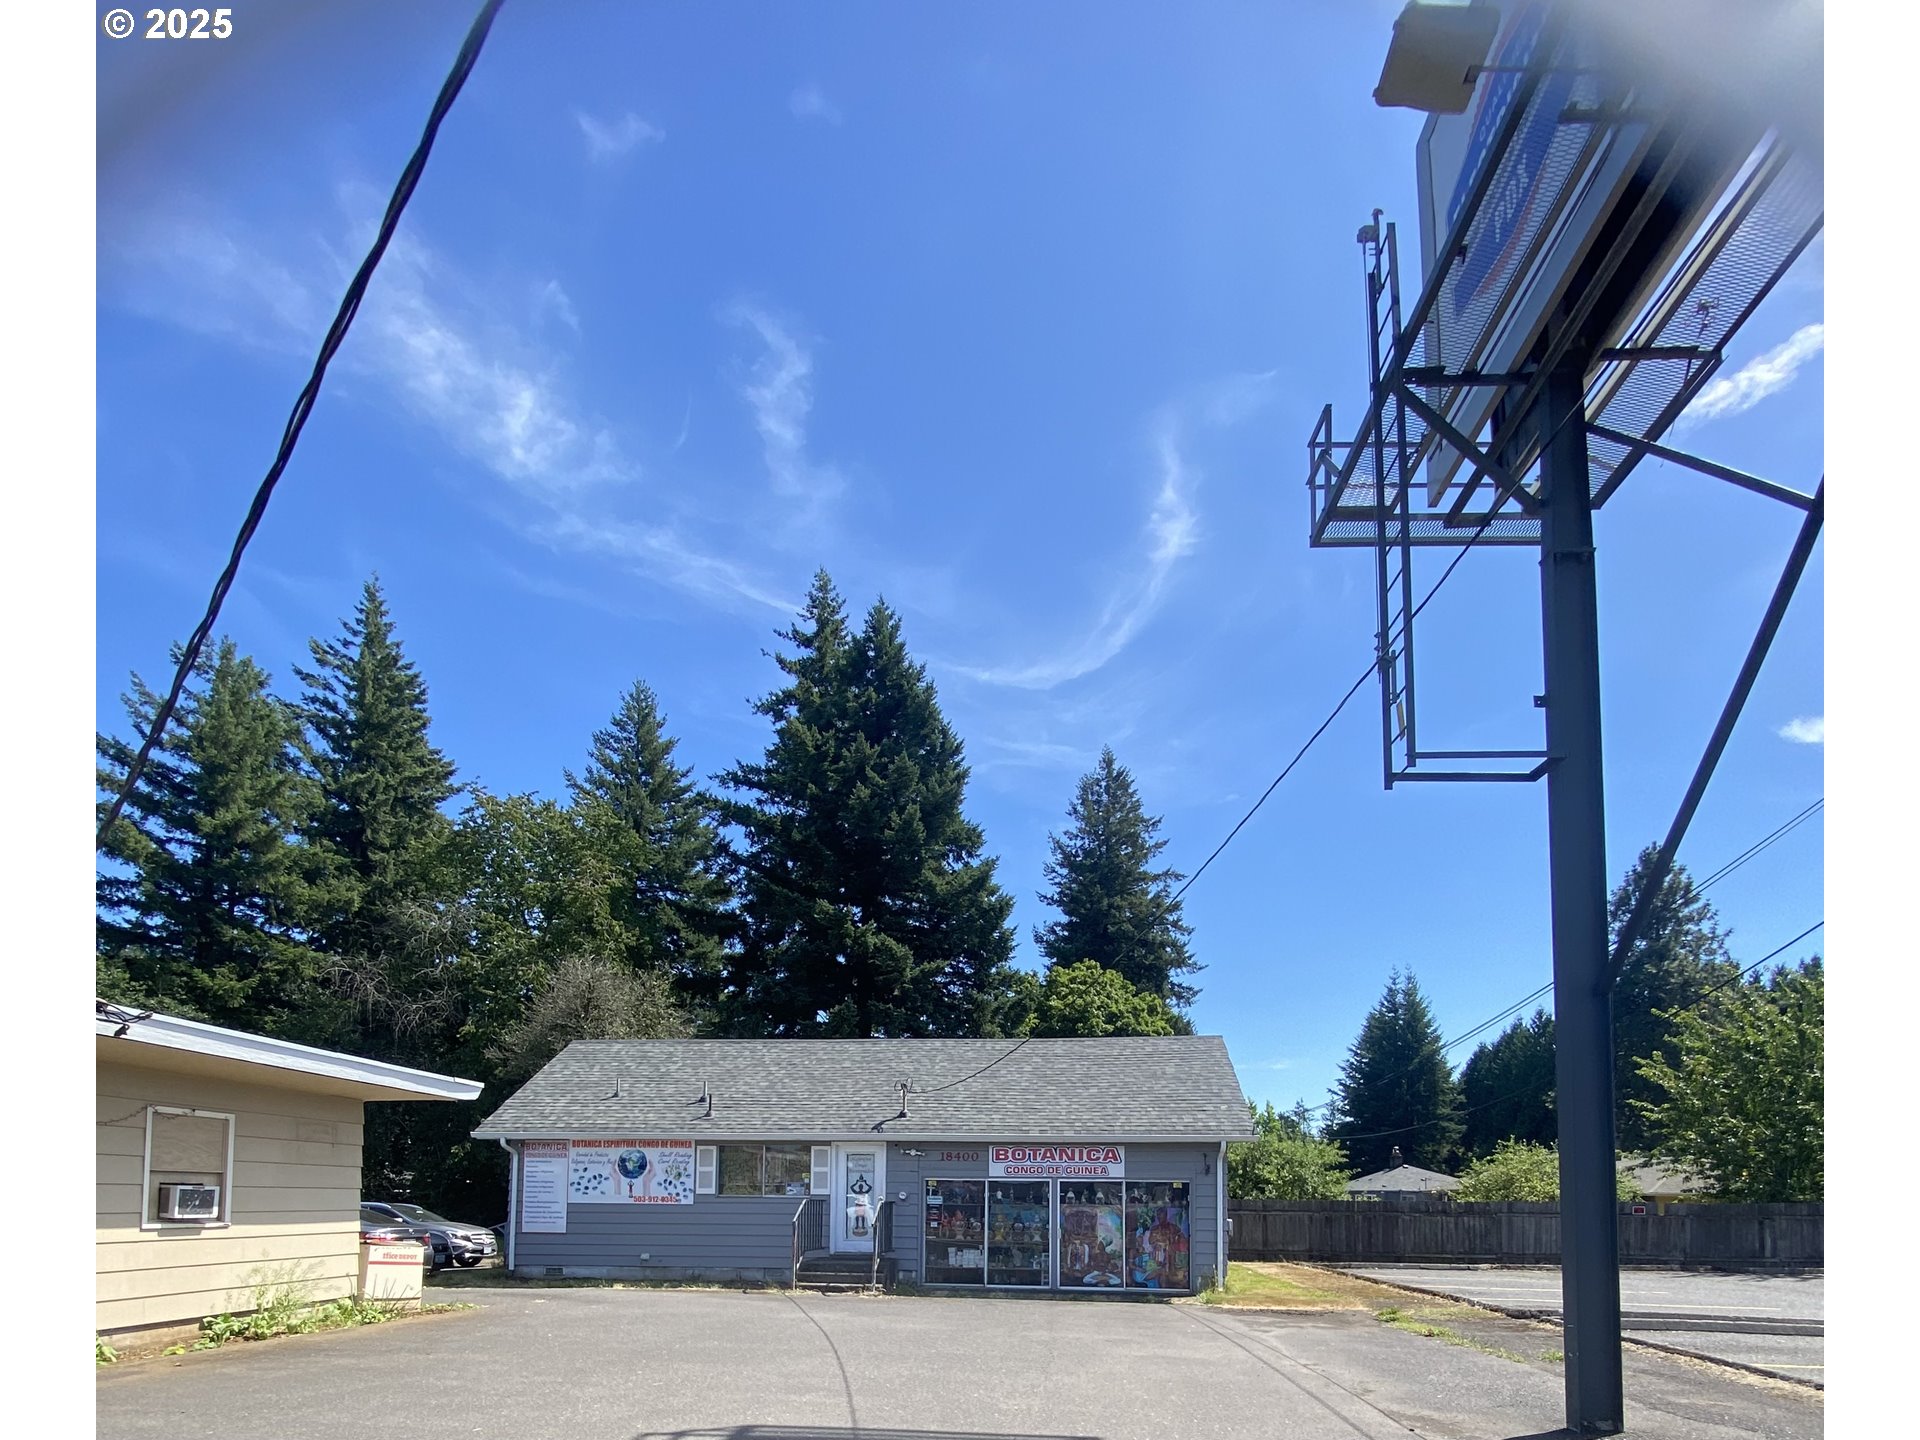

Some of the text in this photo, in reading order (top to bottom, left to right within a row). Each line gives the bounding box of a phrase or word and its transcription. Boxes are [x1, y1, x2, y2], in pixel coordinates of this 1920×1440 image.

[525, 1141, 567, 1151] BOTANICA
[639, 1140, 659, 1149] CONGO
[670, 1140, 693, 1149] GUINEA
[940, 1151, 979, 1162] 18400
[993, 1147, 1121, 1162] BOTANICA
[1005, 1166, 1109, 1175] CONGO DE GUINEA
